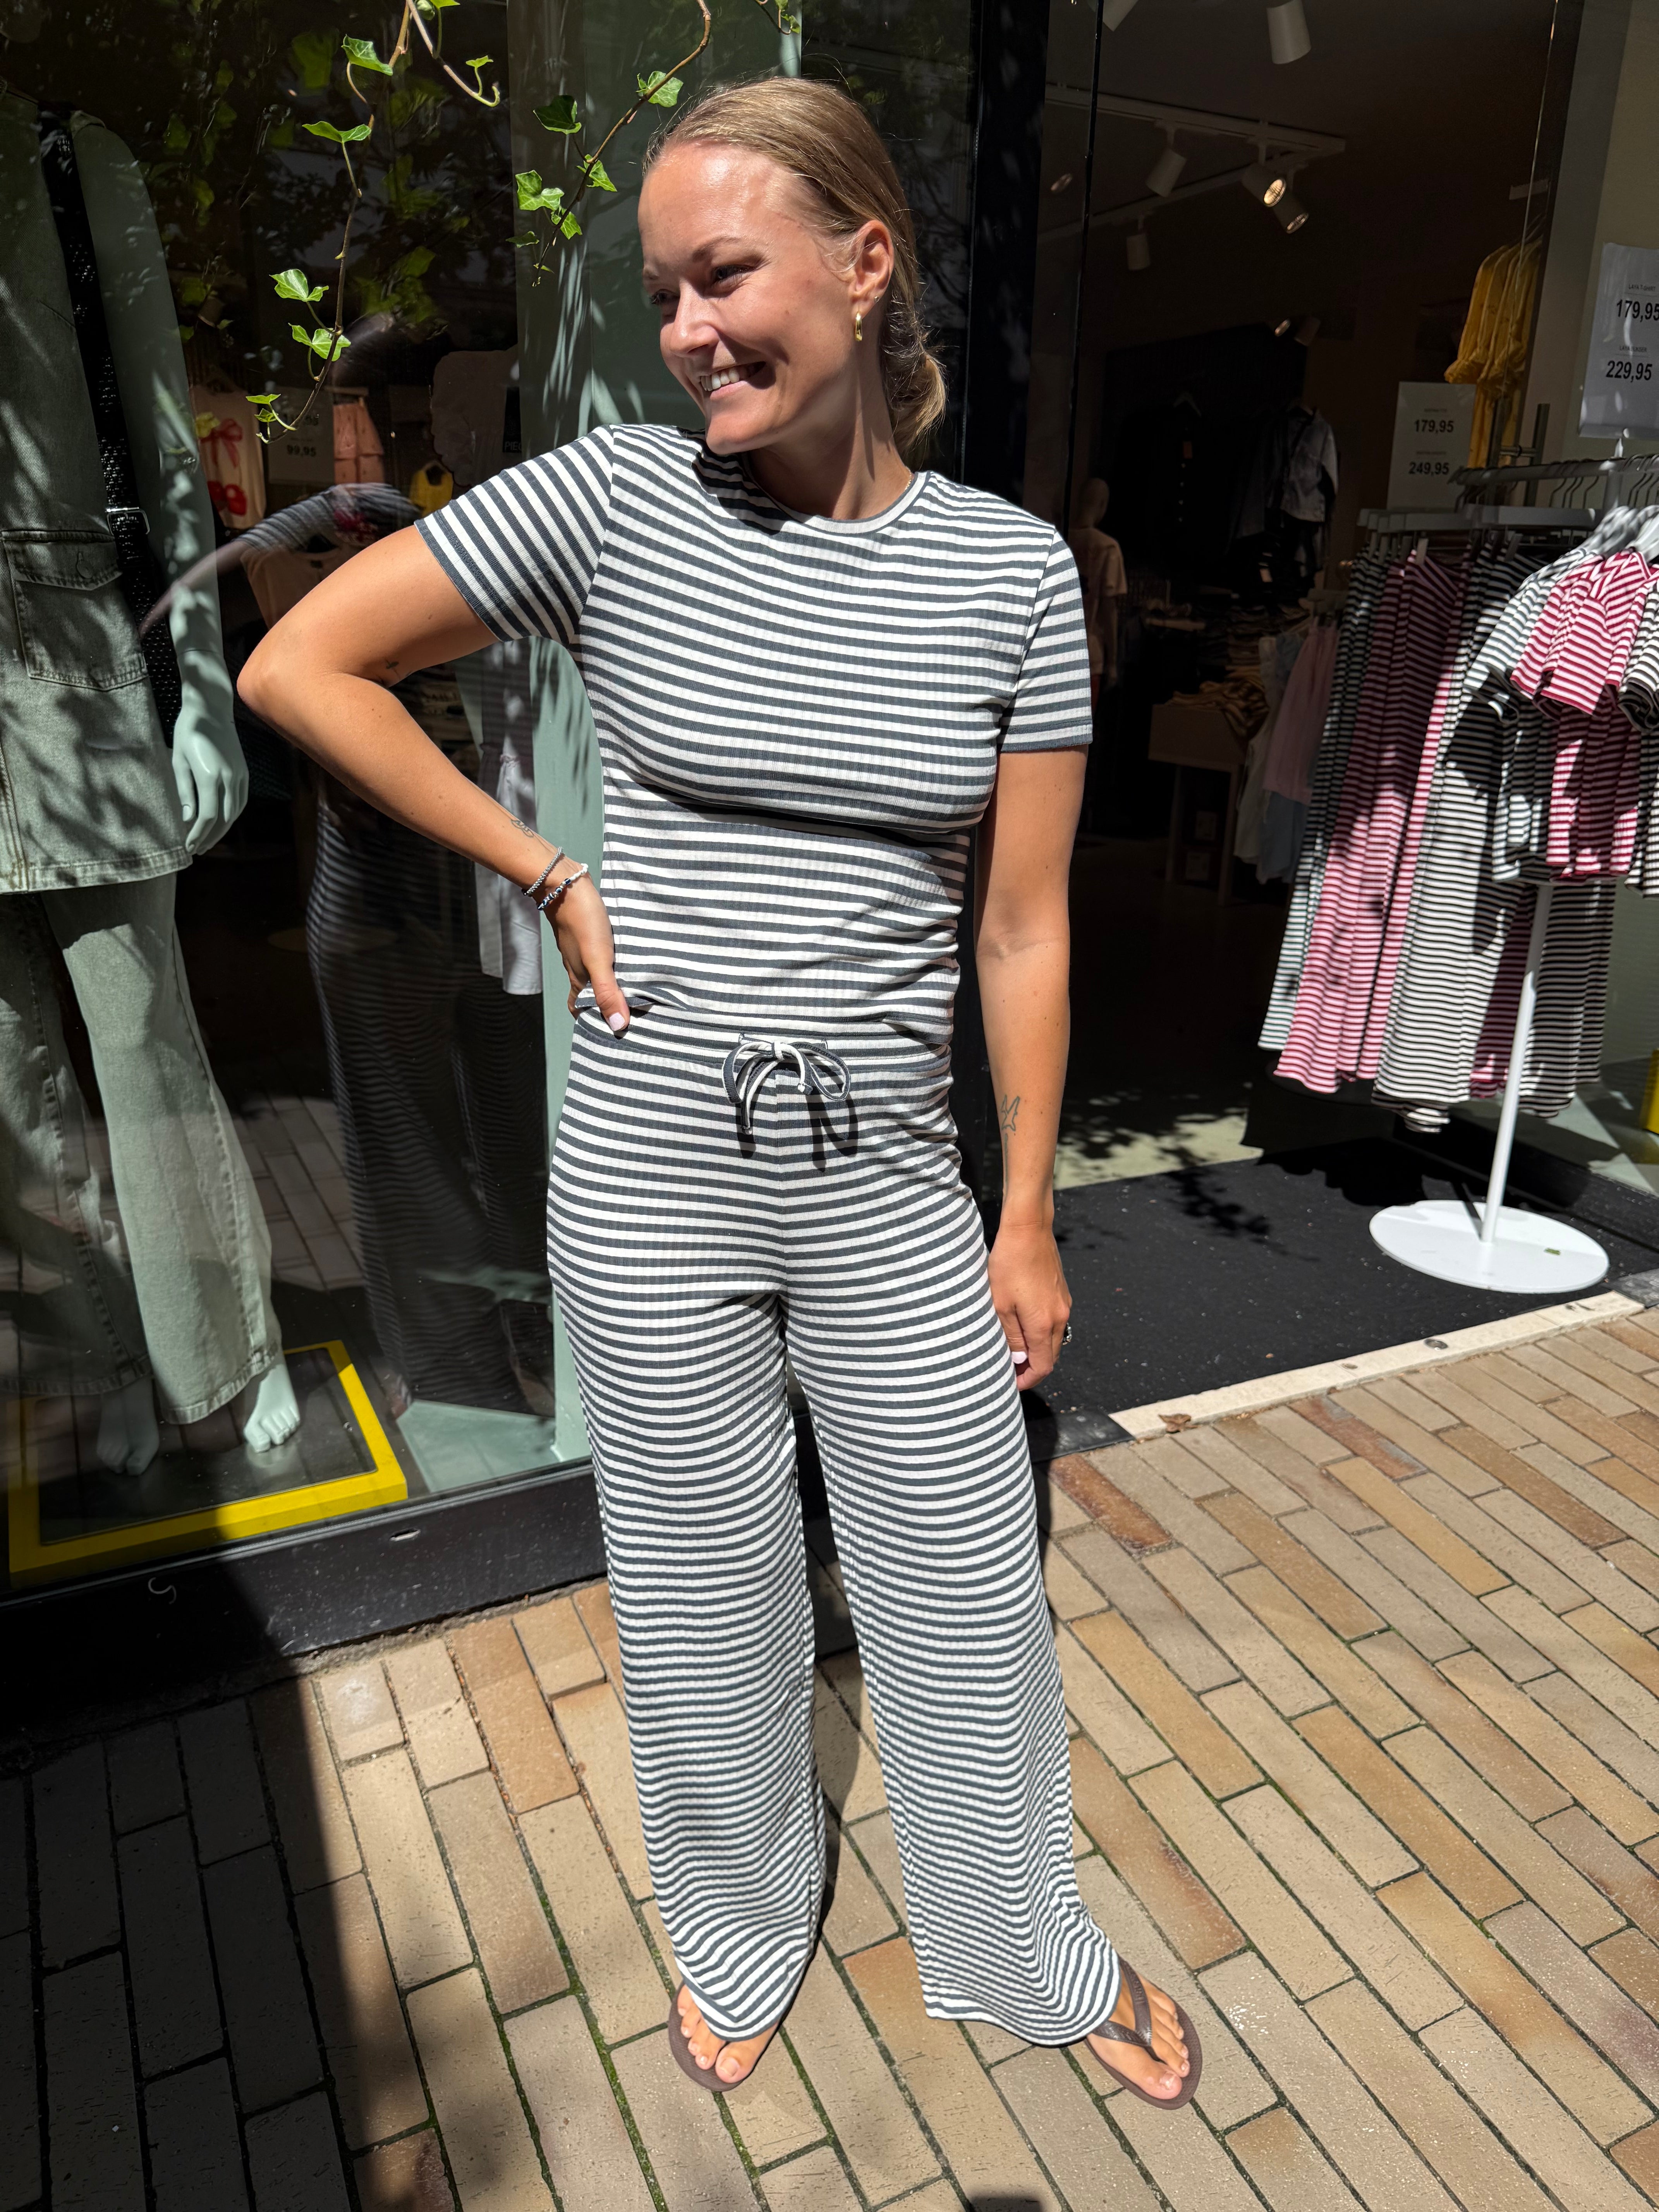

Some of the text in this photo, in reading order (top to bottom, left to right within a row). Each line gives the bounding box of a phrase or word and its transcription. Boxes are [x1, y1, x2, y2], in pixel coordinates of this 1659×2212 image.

[1616, 299, 1659, 323] 179,95
[1606, 360, 1652, 383] 229,95
[1414, 419, 1454, 434] 179,95
[1408, 461, 1449, 477] 249,95
